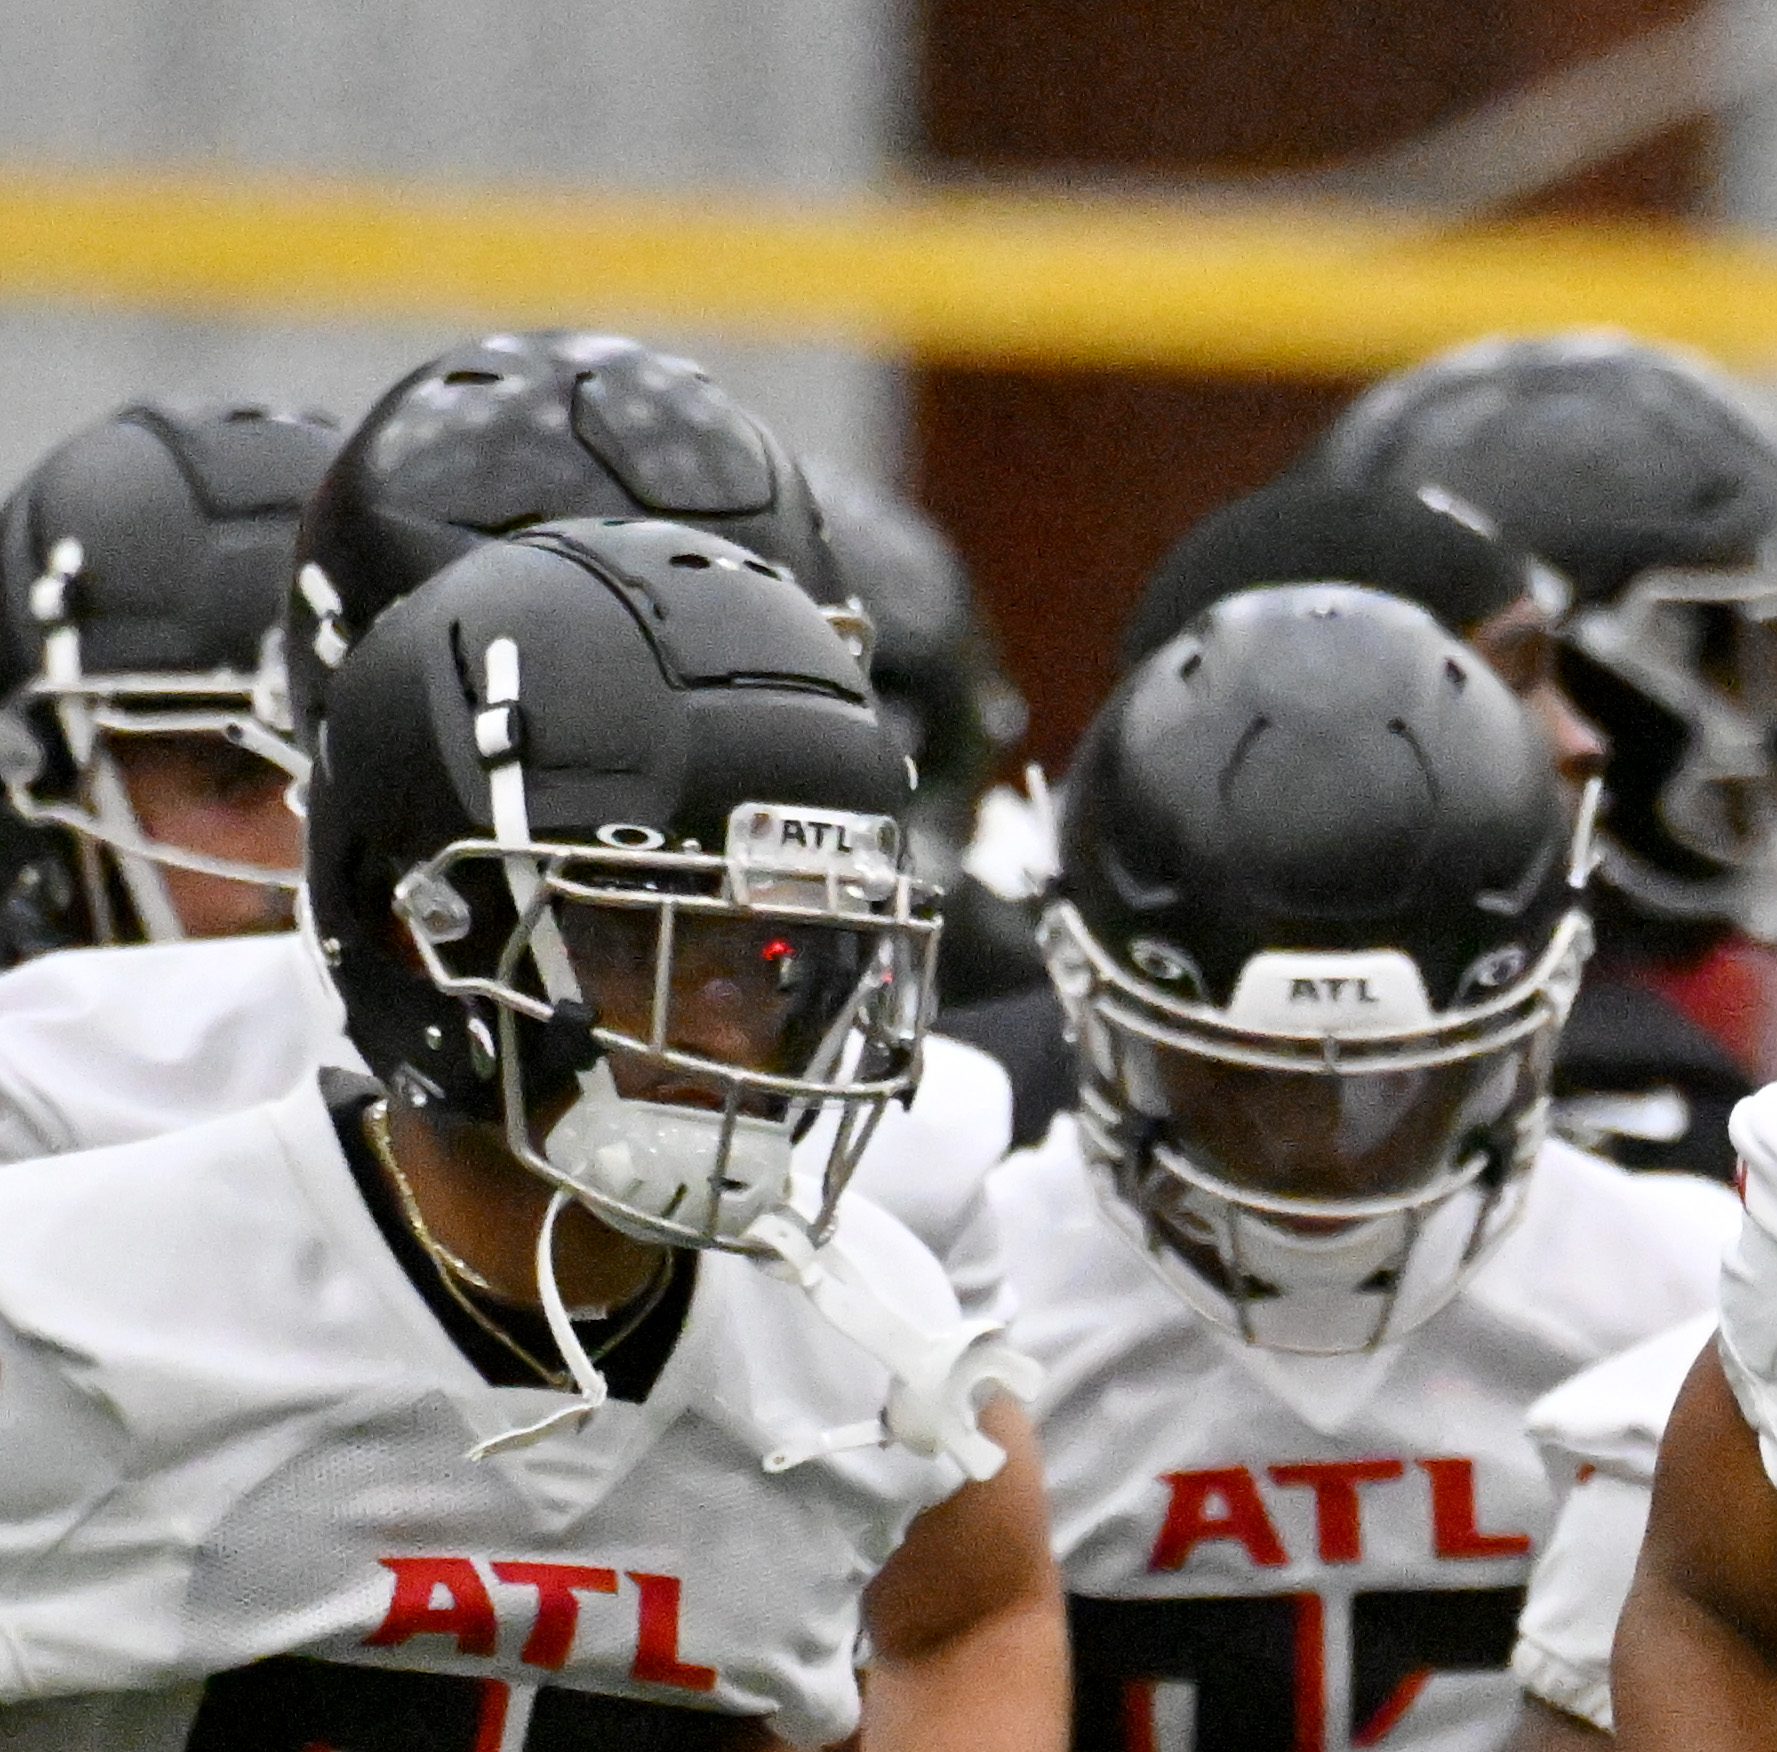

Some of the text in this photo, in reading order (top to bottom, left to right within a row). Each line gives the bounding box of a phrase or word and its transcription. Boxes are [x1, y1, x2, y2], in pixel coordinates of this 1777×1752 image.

[780, 819, 853, 853] ATL
[1290, 978, 1380, 1003] ATL
[1150, 1458, 1531, 1574] ATL
[363, 1556, 718, 1690] ATL
